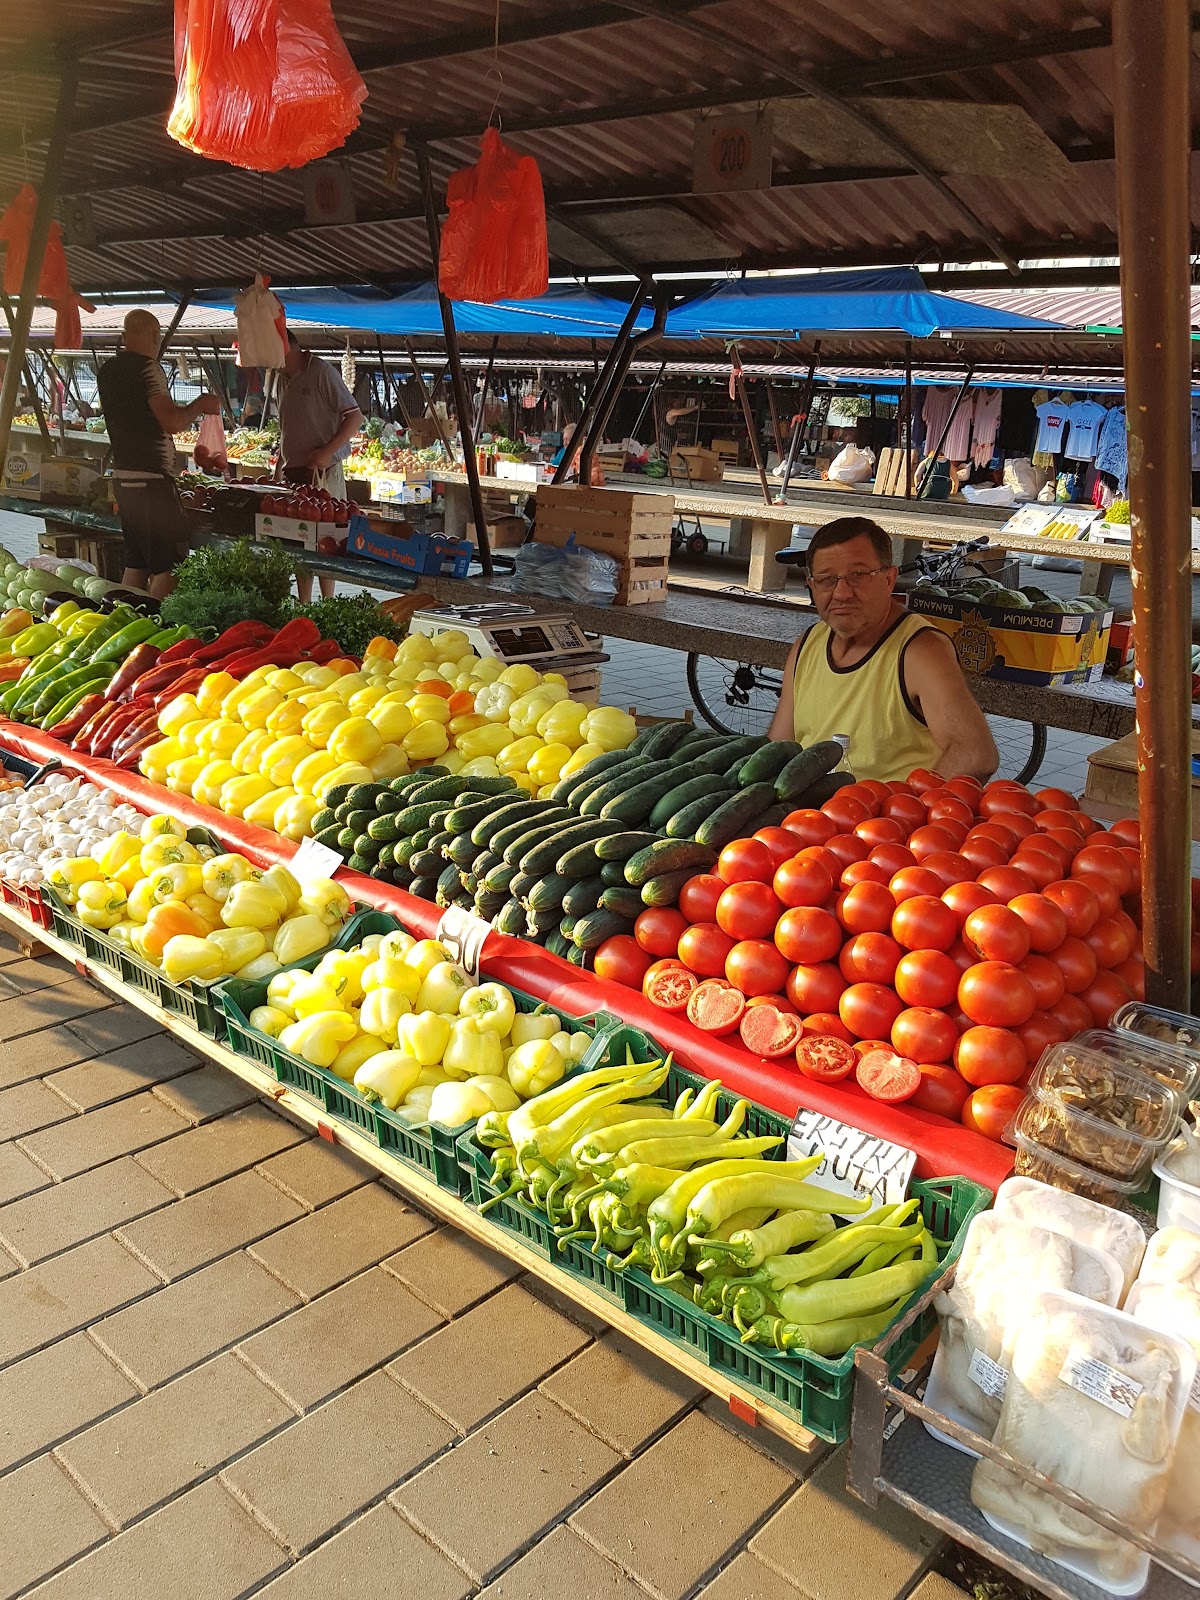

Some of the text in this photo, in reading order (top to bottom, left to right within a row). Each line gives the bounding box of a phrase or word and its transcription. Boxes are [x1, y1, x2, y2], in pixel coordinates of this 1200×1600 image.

[367, 542, 416, 567] Vasia Fruits
[913, 598, 954, 615] BANANAS
[1003, 613, 1054, 629] PREMIUM
[959, 642, 987, 660] Fruit
[963, 657, 980, 672] Le
[790, 1106, 911, 1189] EKSTRA
